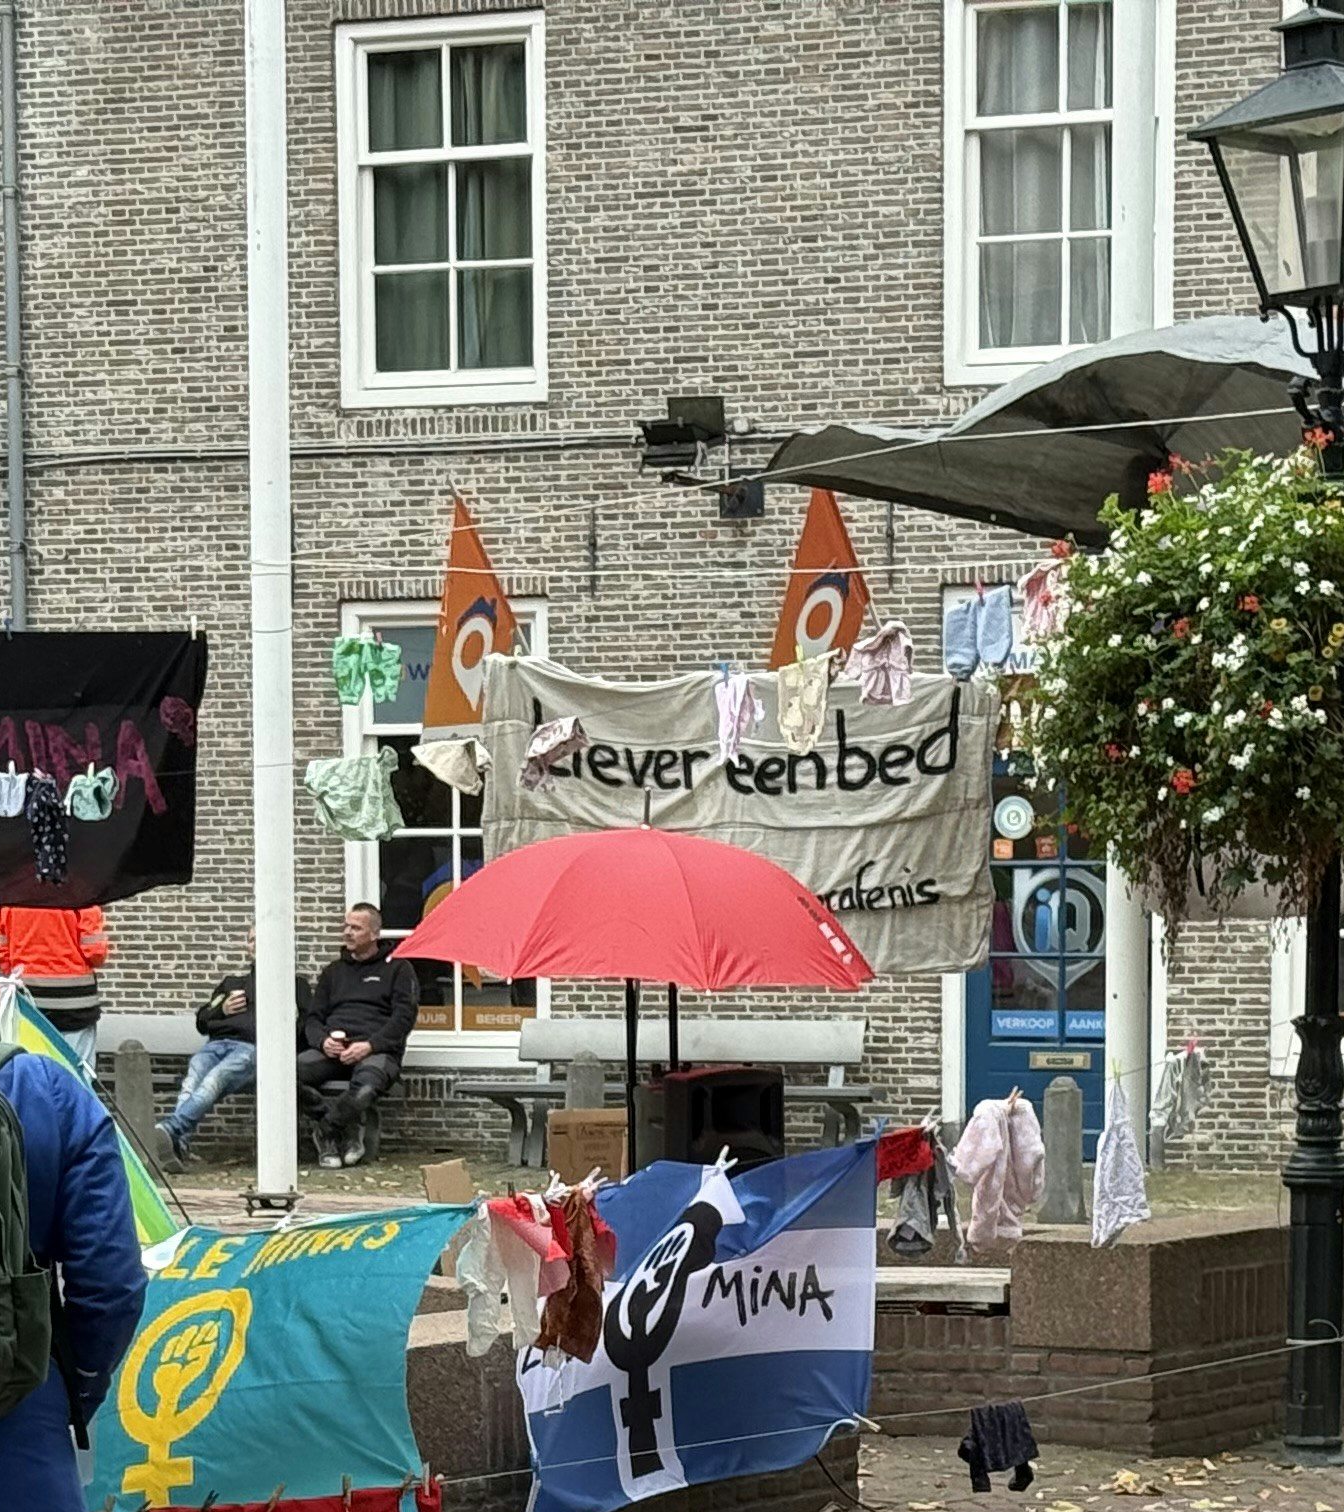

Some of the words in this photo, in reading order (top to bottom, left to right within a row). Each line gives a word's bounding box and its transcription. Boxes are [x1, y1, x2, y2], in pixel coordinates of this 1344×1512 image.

[725, 748, 827, 796] een
[836, 686, 962, 792] bed
[475, 1013, 522, 1024] BEHEER
[996, 1015, 1055, 1030] VERKOOP
[1068, 1016, 1105, 1030] AANK
[158, 1237, 248, 1280] LE
